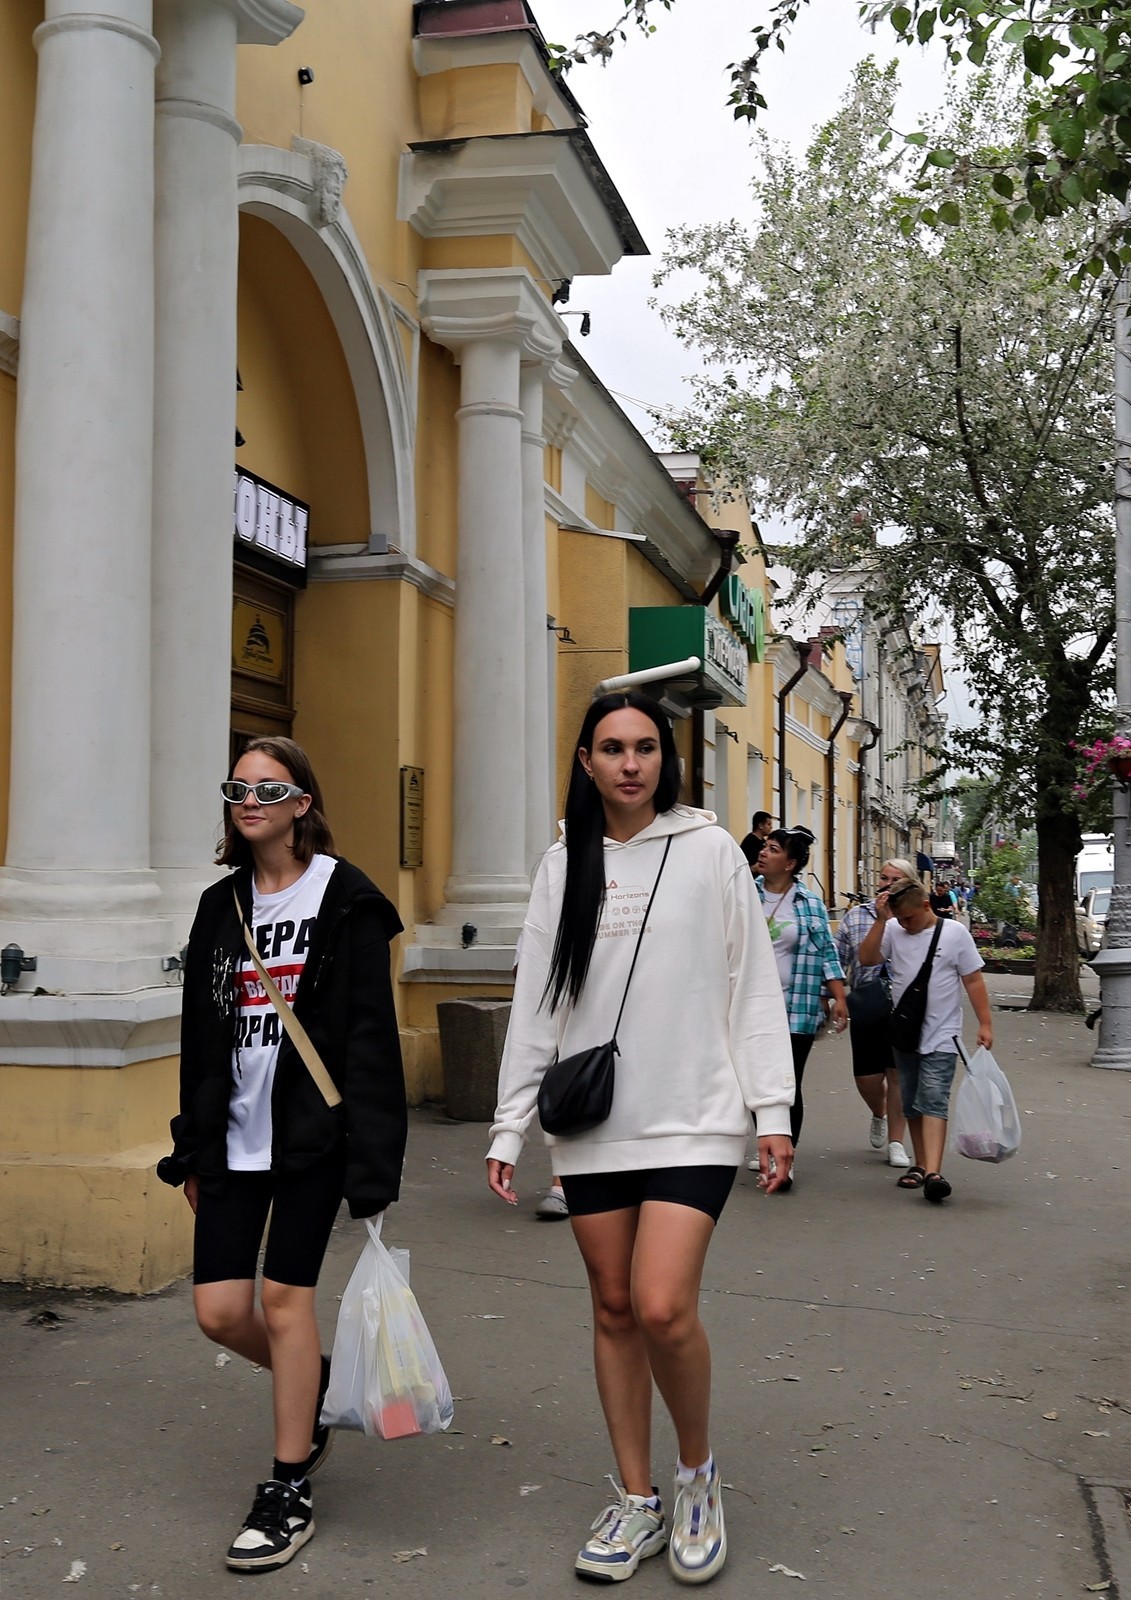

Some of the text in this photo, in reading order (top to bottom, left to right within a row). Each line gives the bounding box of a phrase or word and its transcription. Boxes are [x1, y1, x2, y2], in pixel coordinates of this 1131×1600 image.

[233, 471, 308, 568] ОНЫ
[610, 892, 650, 900] Horizons
[612, 921, 625, 929] ON
[597, 927, 652, 939] UMMER SIE
